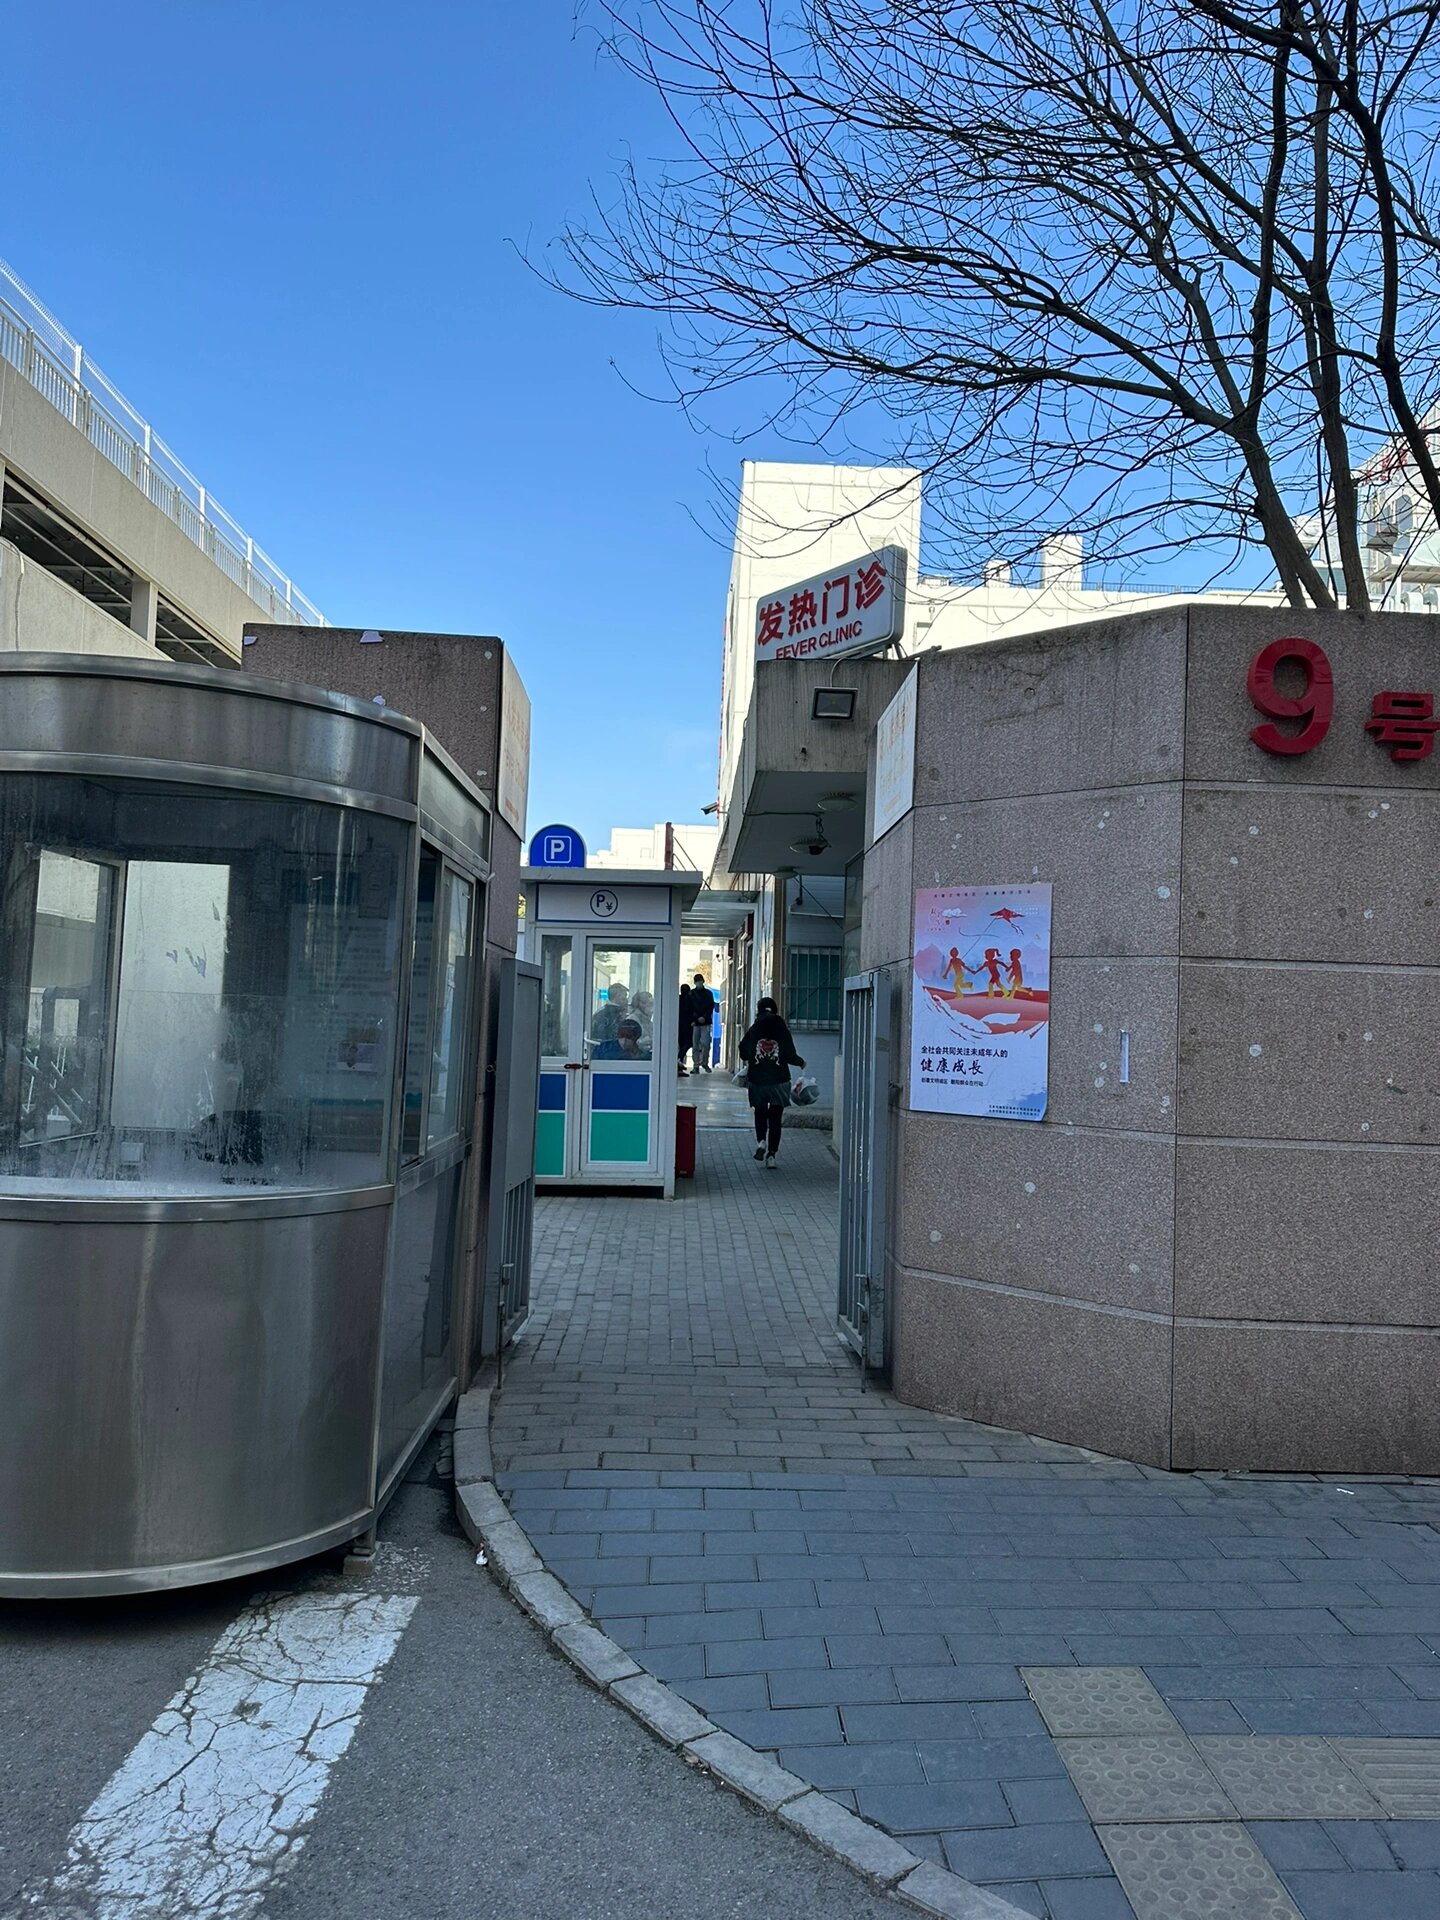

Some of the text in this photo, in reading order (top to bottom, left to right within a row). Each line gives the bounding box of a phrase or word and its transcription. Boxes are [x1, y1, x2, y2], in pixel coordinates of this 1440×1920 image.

[757, 560, 887, 646] 发热门诊
[775, 620, 863, 659] FEVER CLINIC
[550, 839, 565, 860] P
[921, 1045, 1008, 1058] 全社会共同关注未成年人的
